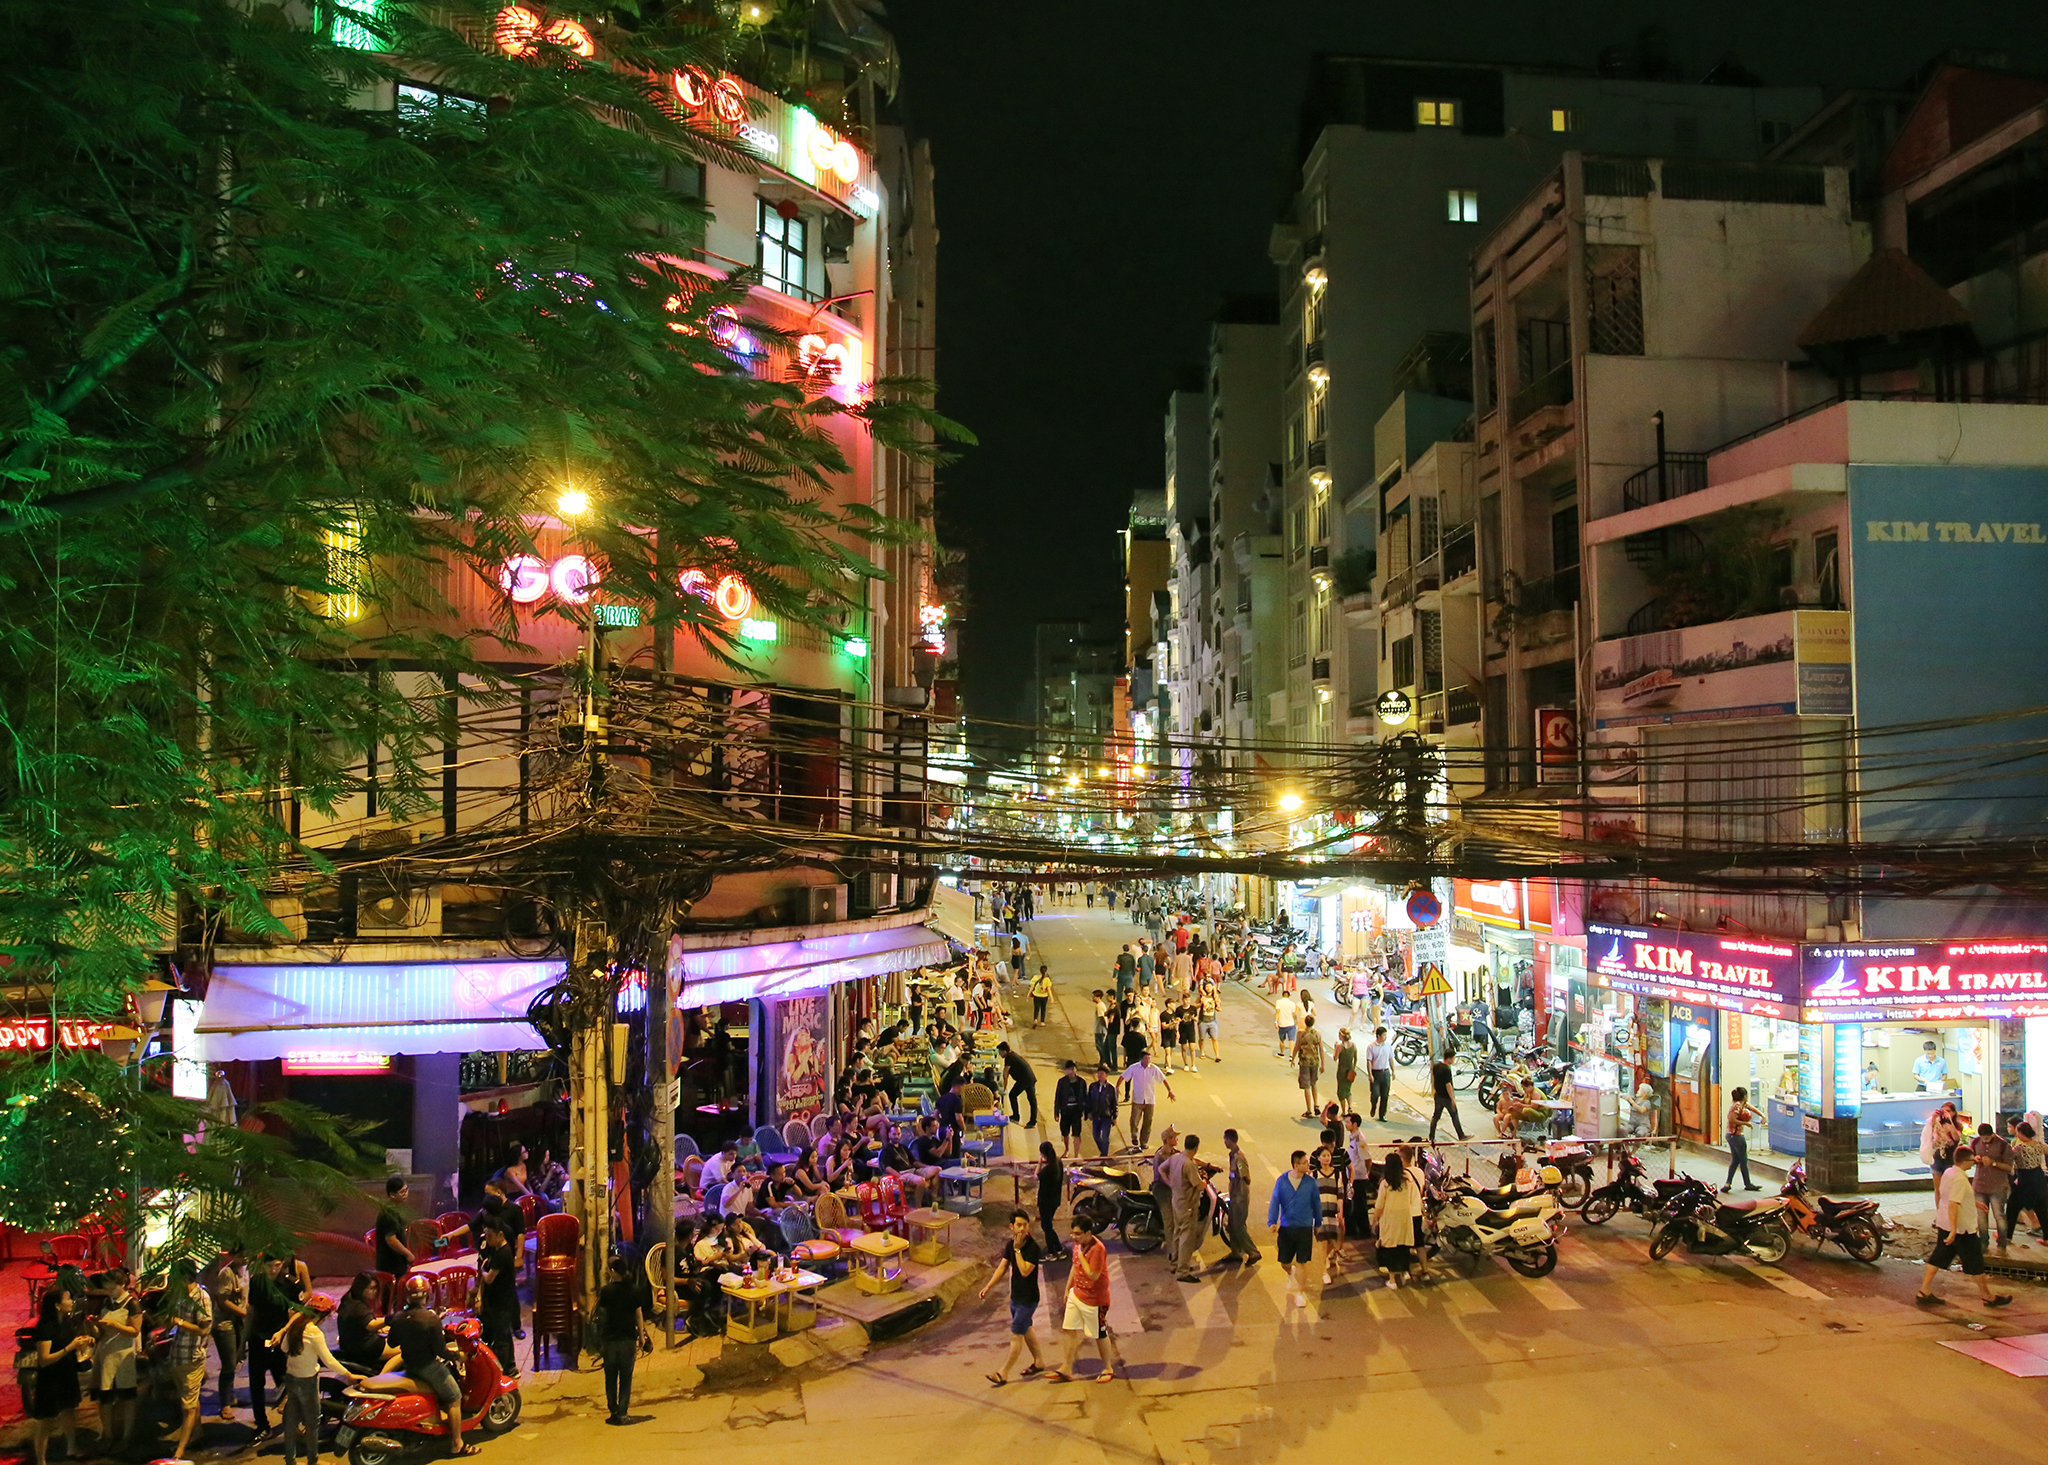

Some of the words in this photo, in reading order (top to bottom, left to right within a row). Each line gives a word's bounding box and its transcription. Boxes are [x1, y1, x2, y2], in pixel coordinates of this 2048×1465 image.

[807, 128, 859, 184] GO
[1866, 521, 1930, 542] KIM
[1935, 522, 2047, 544] TRAVEL
[498, 552, 600, 605] GO
[1634, 943, 1694, 976] KIM
[1699, 960, 1773, 988] TRAVEL
[1864, 965, 1951, 993] KIM
[1958, 972, 2047, 990] TRAVEL
[789, 997, 815, 1016] LIVE
[1672, 1005, 1692, 1021] ACB
[782, 1012, 821, 1034] MUSIC
[288, 1050, 352, 1063] STREET
